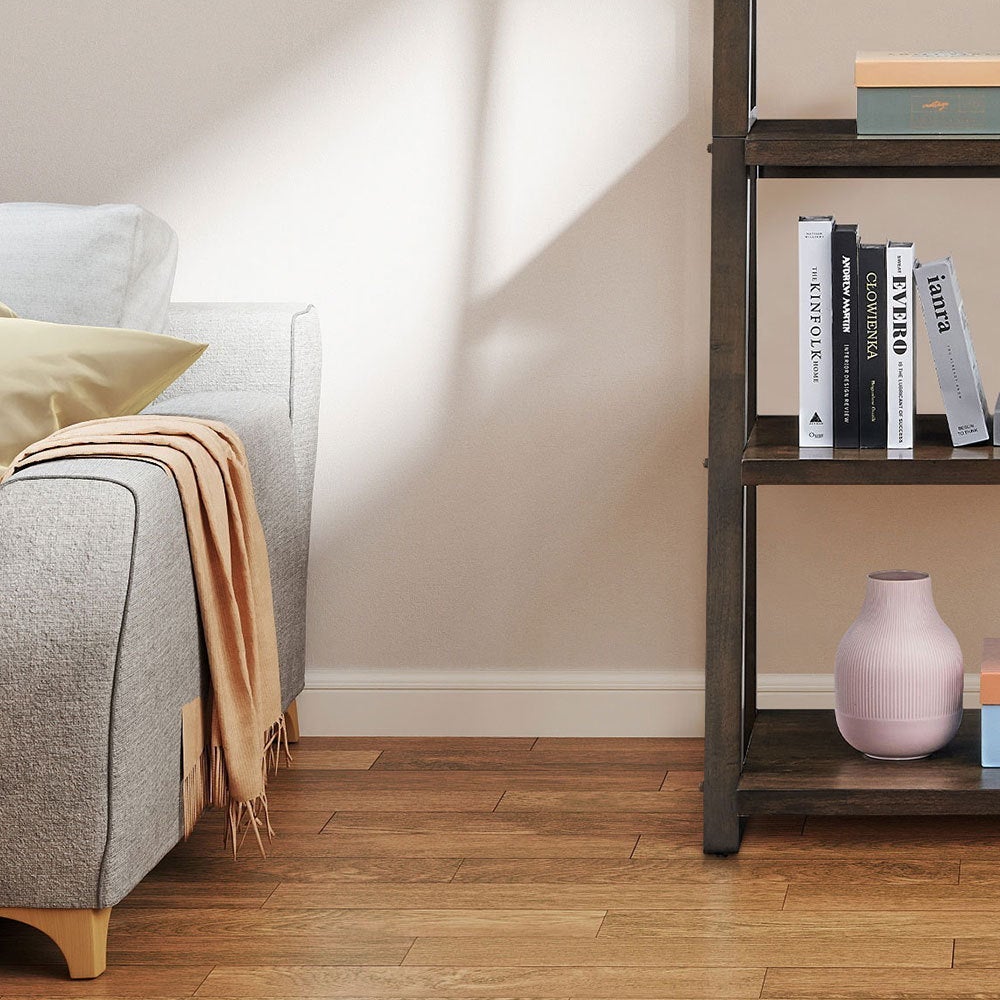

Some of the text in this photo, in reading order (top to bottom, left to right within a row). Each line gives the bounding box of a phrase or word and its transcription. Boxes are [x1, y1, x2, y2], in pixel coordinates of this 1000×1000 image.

[841, 255, 851, 296] ANDREW
[926, 274, 952, 335] ianra
[810, 282, 823, 360] KINFOLK
[841, 297, 851, 334] MARTIN
[892, 275, 908, 355] EVERO
